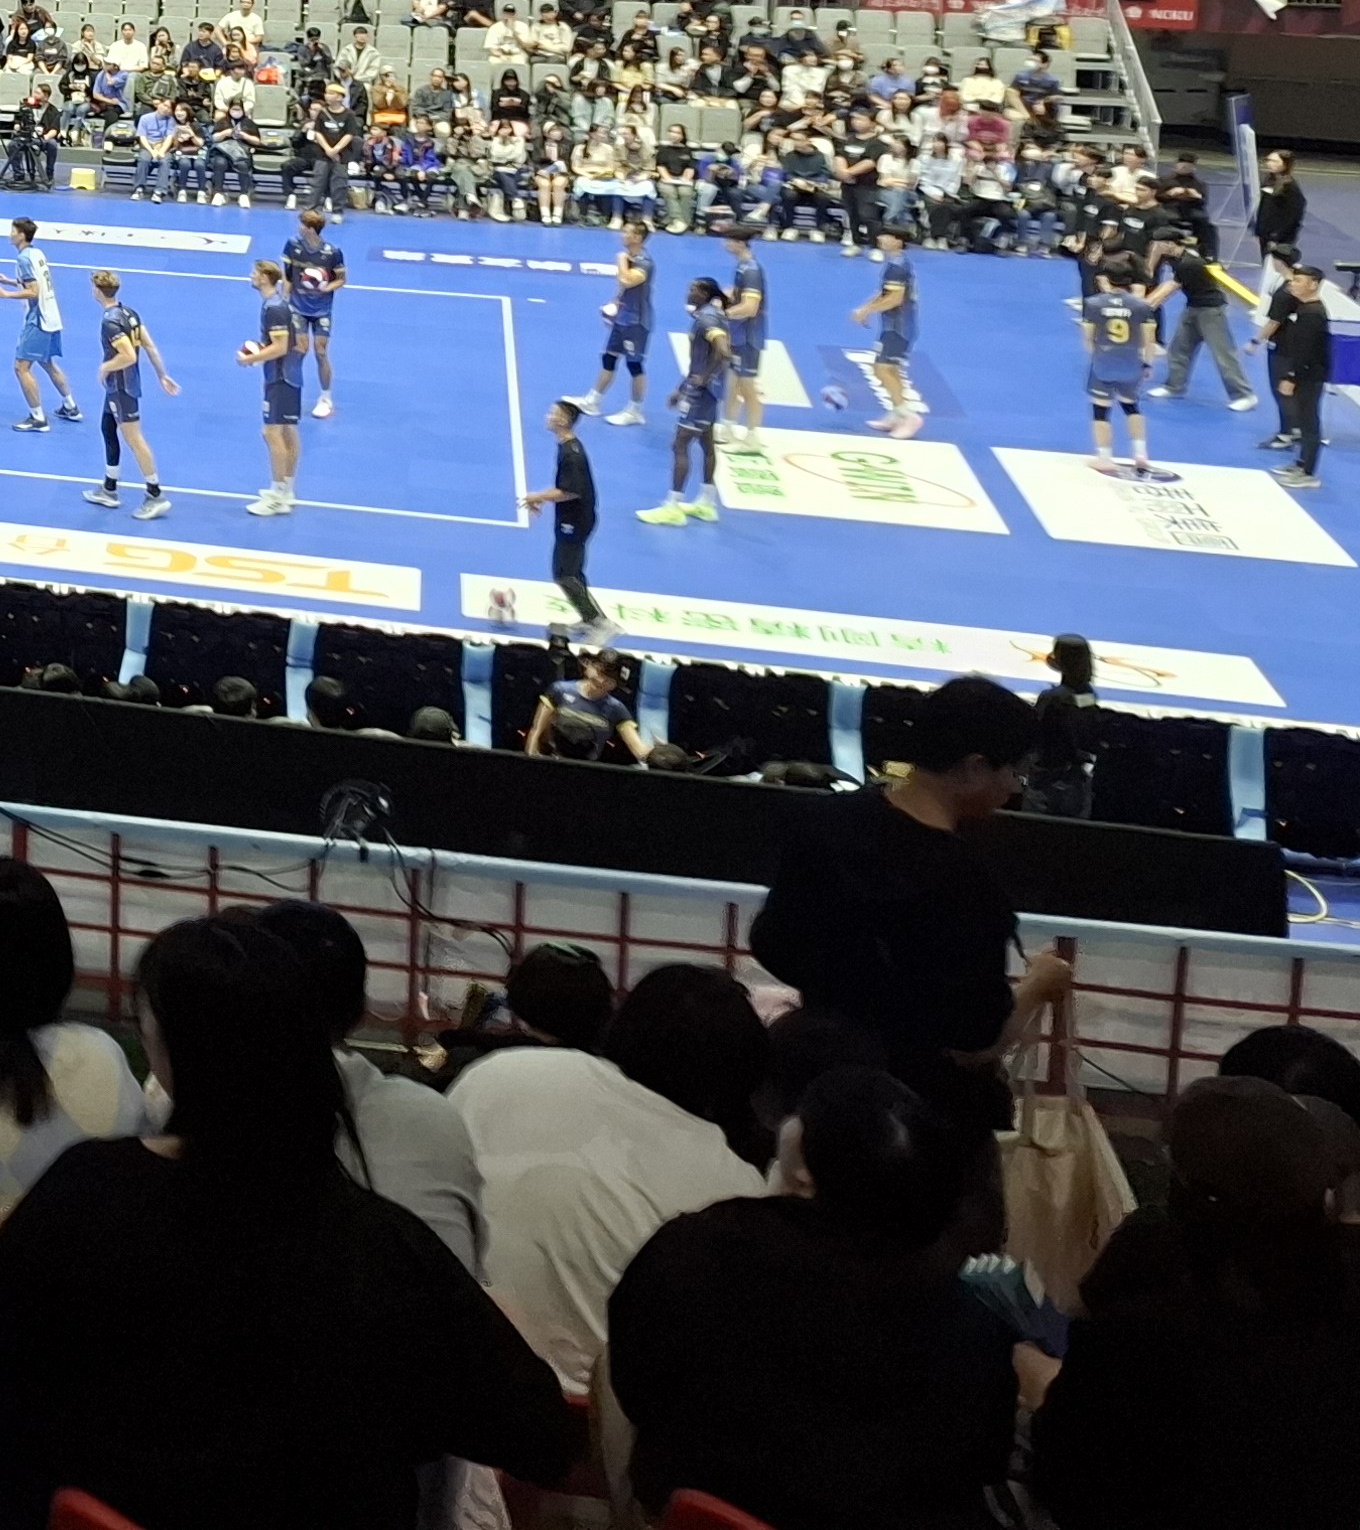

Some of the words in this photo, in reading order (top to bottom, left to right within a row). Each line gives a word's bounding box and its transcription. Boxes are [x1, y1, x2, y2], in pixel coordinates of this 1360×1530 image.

[1148, 9, 1194, 23] NCKU
[1106, 318, 1130, 344] 9
[103, 542, 390, 599] TSG
